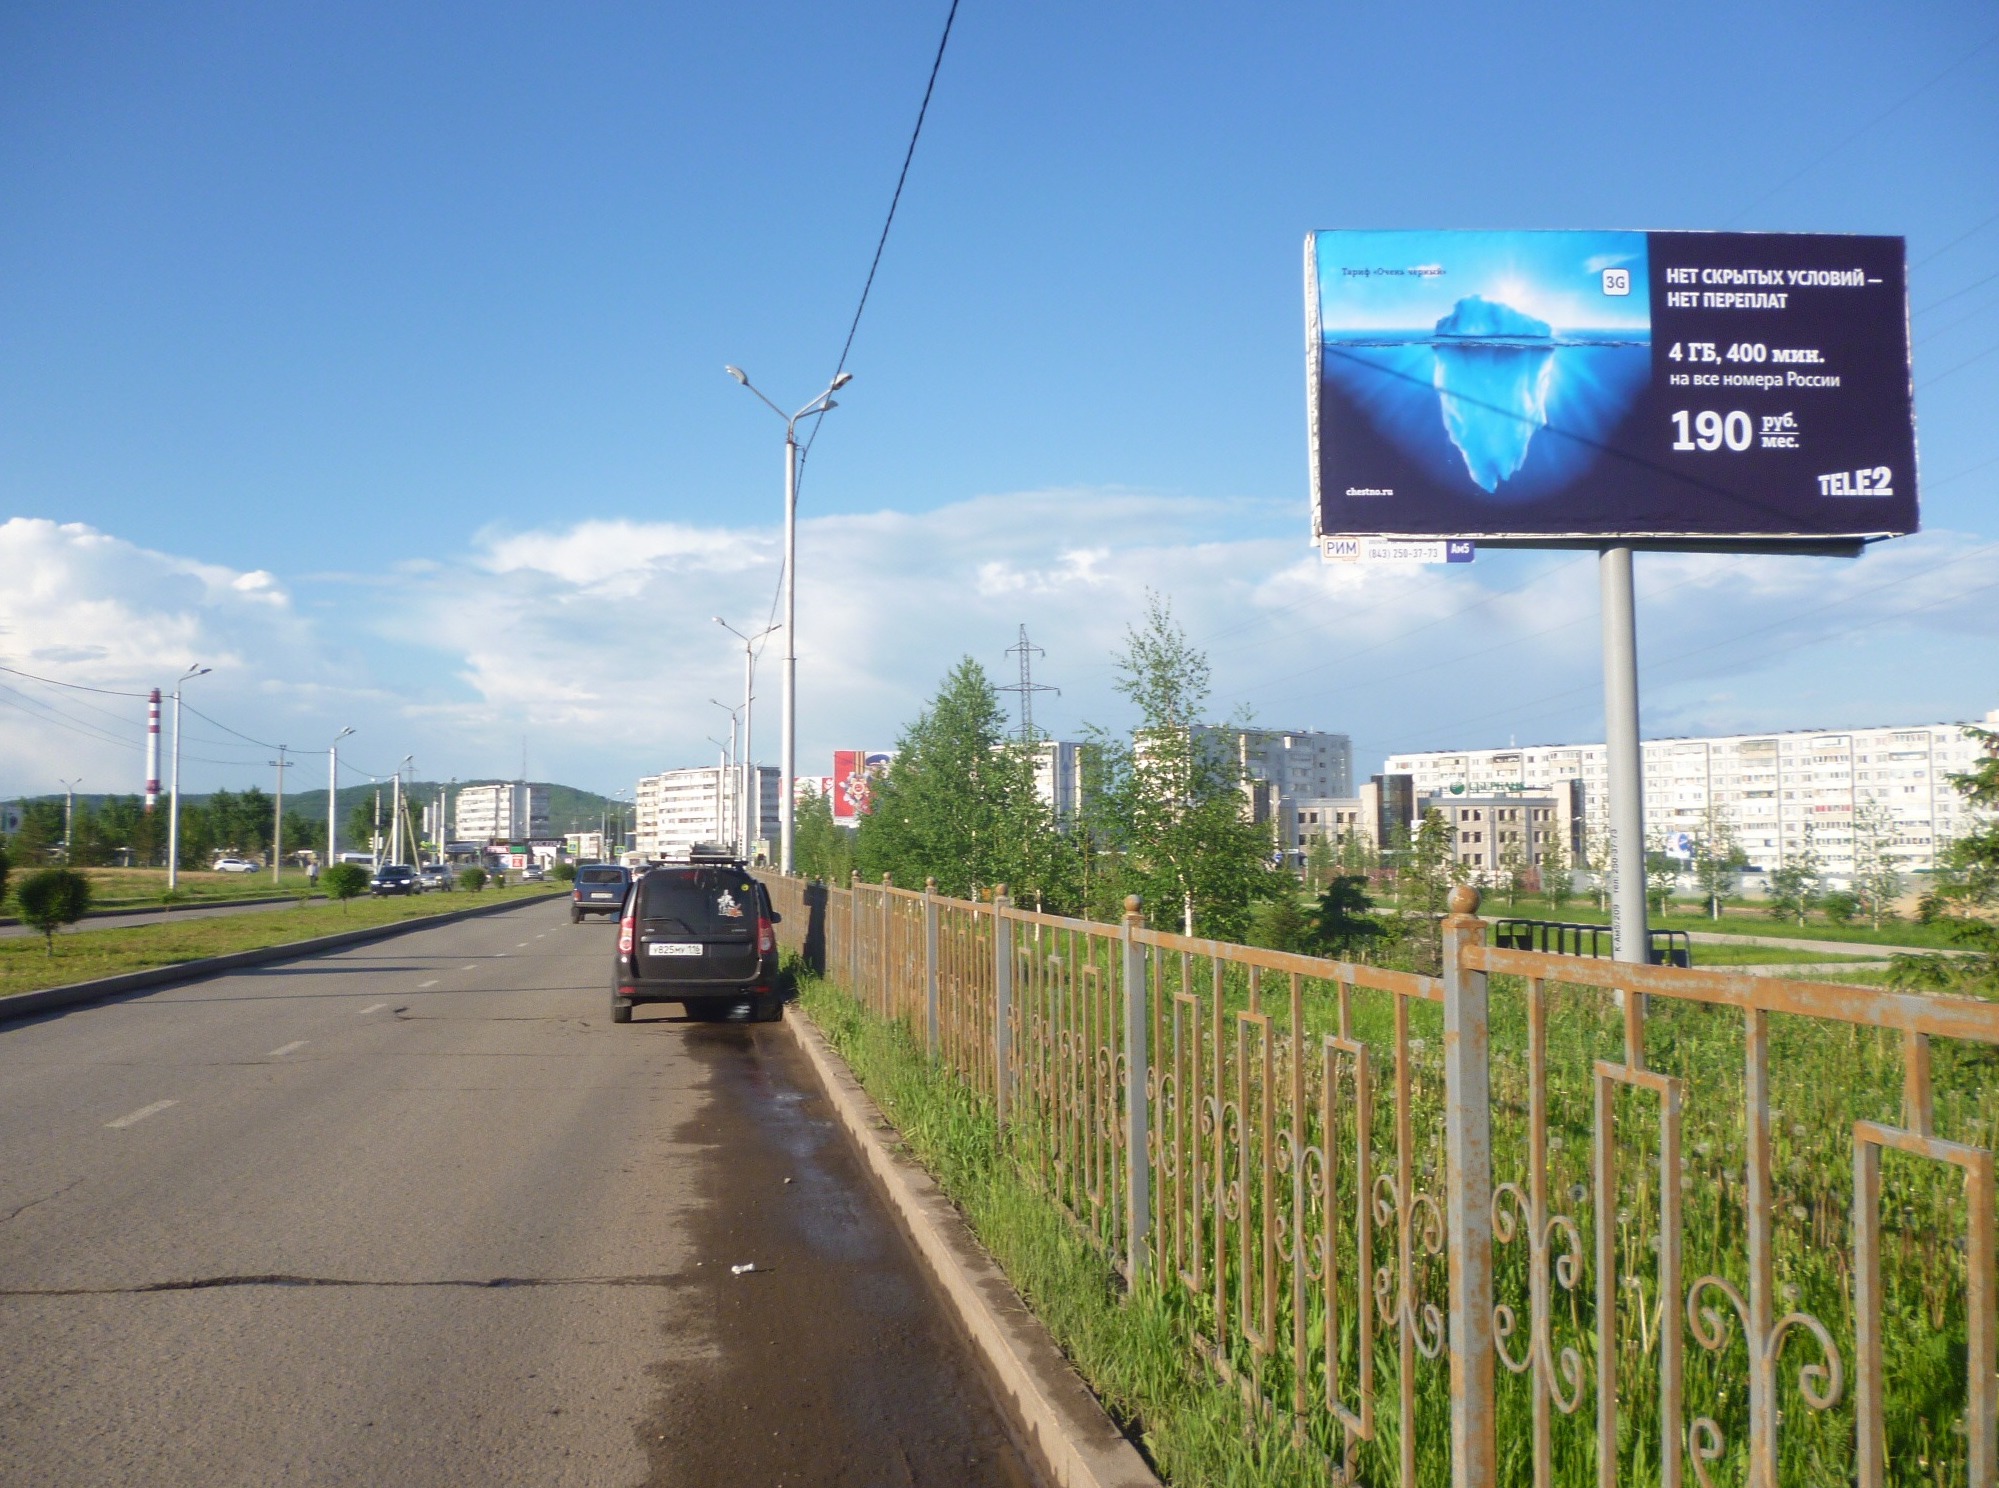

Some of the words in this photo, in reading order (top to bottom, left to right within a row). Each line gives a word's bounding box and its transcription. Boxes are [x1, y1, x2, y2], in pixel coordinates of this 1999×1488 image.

[1342, 267, 1370, 277] Тариф
[1666, 268, 1699, 284] НЕТ
[1701, 269, 1785, 286] СКРЫТЫХ
[1786, 269, 1865, 287] УСЛОВИЙ
[1606, 276, 1625, 289] 3G
[1667, 292, 1700, 307] НЕТ
[1702, 292, 1788, 309] ПЕРЕПЛАТ
[1668, 342, 1683, 362] 4
[1687, 343, 1722, 365] ГБ,
[1726, 343, 1767, 363] 400
[1772, 349, 1826, 364] мин.
[1669, 373, 1690, 386] на
[1693, 374, 1719, 386] все
[1723, 374, 1783, 391] номера
[1786, 371, 1841, 387] России
[1671, 410, 1752, 451] 190
[1761, 411, 1798, 432] руб.
[1761, 436, 1800, 448] мес.
[1817, 466, 1893, 496] TELE2
[1345, 487, 1394, 496] chestno.ru
[1327, 541, 1357, 554] РИМ
